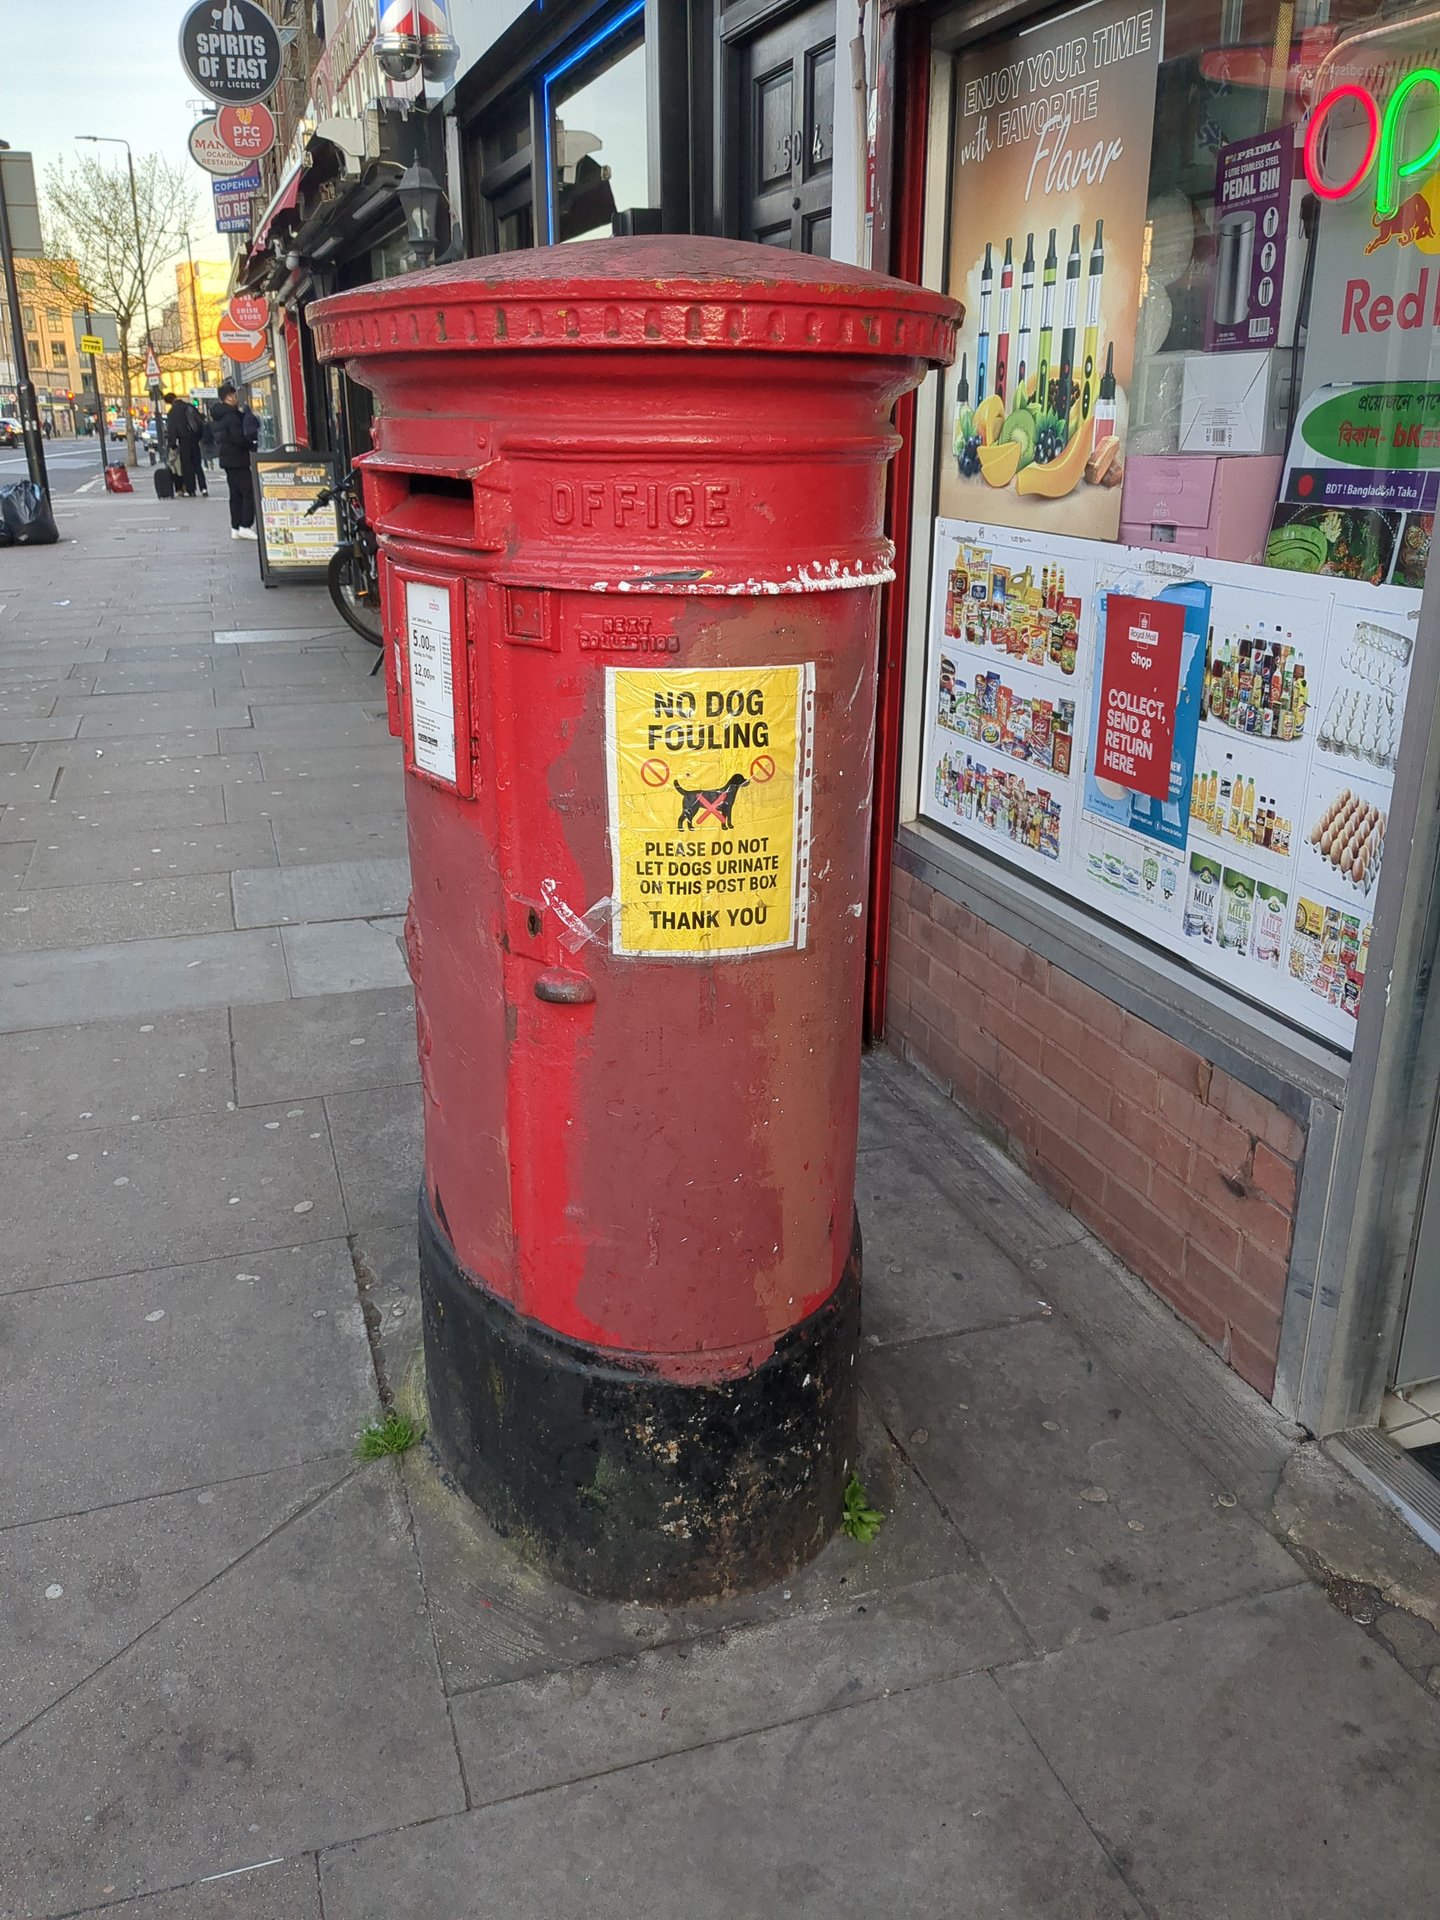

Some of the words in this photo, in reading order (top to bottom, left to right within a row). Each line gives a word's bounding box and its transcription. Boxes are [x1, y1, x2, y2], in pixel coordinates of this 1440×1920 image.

[196, 33, 266, 57] SPIRITS
[198, 56, 220, 78] OF
[226, 57, 268, 80] EAST
[964, 61, 1024, 116] ENJOY
[1026, 37, 1087, 92] YOUR
[1092, 9, 1153, 69] TIME
[209, 80, 224, 88] OFF
[227, 80, 261, 90] LICENCE
[232, 125, 260, 138] PFC
[961, 115, 994, 166] with
[997, 79, 1100, 148] FAVORITE
[234, 138, 262, 148] EAST
[1236, 140, 1282, 161] PRIMA
[202, 158, 248, 168] RESTAURANT
[1024, 112, 1124, 202] Flavor
[1264, 155, 1280, 168] STEEL
[1222, 173, 1257, 203] PEDAL
[1259, 166, 1281, 193] BIN
[217, 203, 231, 219] TO
[1341, 267, 1430, 335] Red
[84, 344, 102, 352] TYRES
[1397, 486, 1418, 498] Taka
[551, 480, 731, 528] OFFICE
[602, 616, 652, 635] NEXT
[1130, 628, 1145, 640] Royal
[1145, 631, 1157, 642] Mail
[578, 632, 680, 653] COLLECTION
[1130, 651, 1152, 671] Shop
[654, 690, 695, 718] NO
[706, 689, 764, 717] DOG
[1108, 688, 1166, 724] COLLECT,
[1106, 708, 1140, 734] SEND
[1141, 719, 1152, 739] &
[647, 721, 770, 751] FOULING
[1105, 728, 1153, 760] RETURN
[1103, 748, 1137, 777] HERE.
[645, 841, 706, 857] PLEASE
[711, 840, 734, 857] DO
[738, 837, 769, 856] NOT
[636, 860, 664, 877] LET
[668, 860, 713, 876] DOGS
[717, 855, 779, 874] URINATE
[639, 880, 663, 895] ON
[669, 880, 702, 896] THIS
[706, 878, 745, 894] POST
[749, 874, 778, 892] BOX
[1193, 888, 1215, 909] MILK
[649, 910, 721, 930] THANK
[727, 907, 768, 927] YOU
